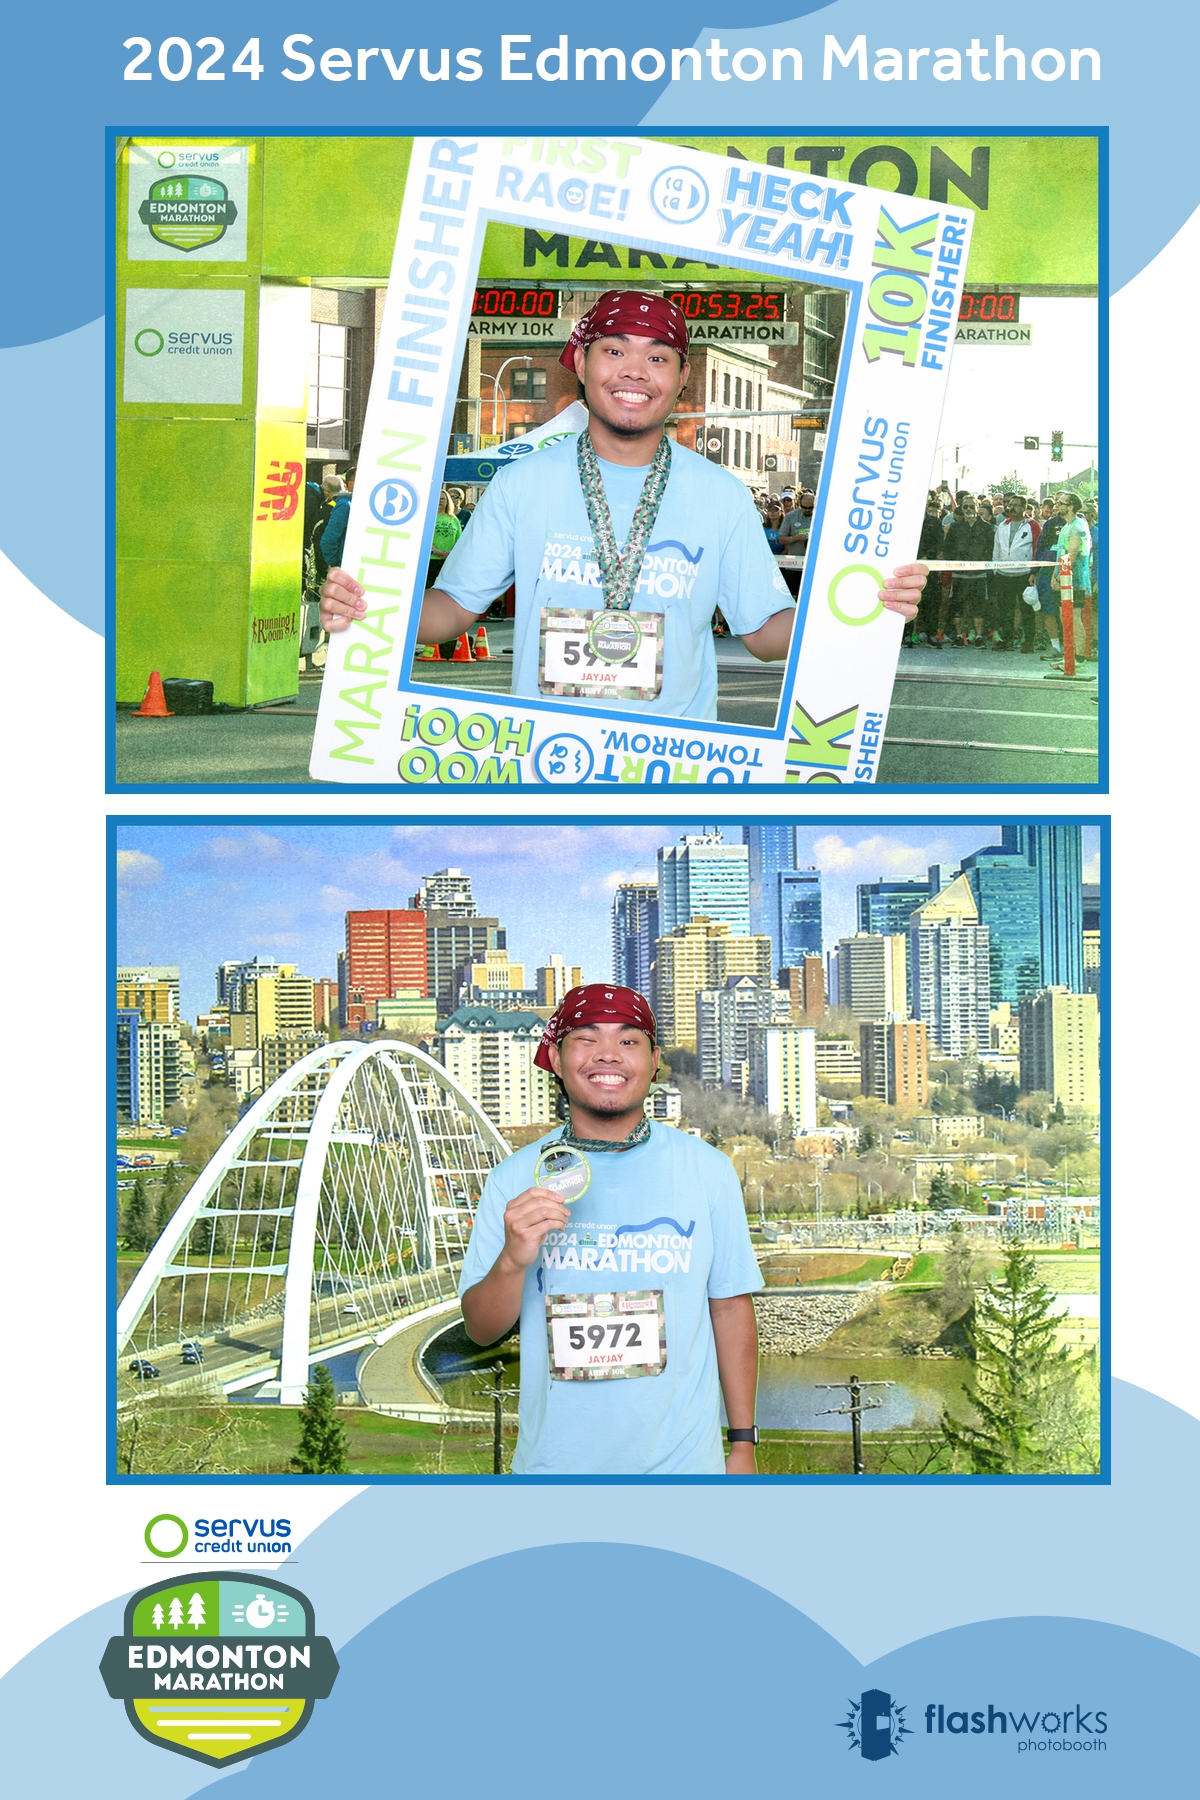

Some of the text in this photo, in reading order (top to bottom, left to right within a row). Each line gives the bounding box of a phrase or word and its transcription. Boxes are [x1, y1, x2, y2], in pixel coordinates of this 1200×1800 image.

[178, 152, 220, 162] servus
[494, 164, 632, 223] RACE!
[720, 165, 857, 229] HECK
[149, 202, 228, 214] EDMONTON
[160, 213, 216, 222] MARATHON
[715, 208, 855, 272] YEAH!
[862, 204, 939, 368] 10K
[920, 214, 968, 371] FINISHER!
[468, 321, 554, 336] ARMY 10K
[168, 331, 234, 345] servus
[167, 345, 233, 355] credit union
[329, 137, 479, 765] MARATHON FINISHER
[843, 415, 889, 555] servus
[874, 420, 911, 558] credit union
[553, 531, 579, 541] servus
[544, 541, 583, 560] 2024
[580, 672, 618, 682] JAYJAY
[579, 686, 618, 695] ARMY 10K
[600, 729, 764, 767] TOMORROW.
[574, 1220, 596, 1230] credit
[598, 1232, 693, 1250] EDMONTON
[540, 1246, 692, 1274] MARATHON
[569, 1322, 643, 1351] 5972
[587, 1353, 624, 1364] JAYJAY
[588, 1367, 626, 1377] ARMY 10K
